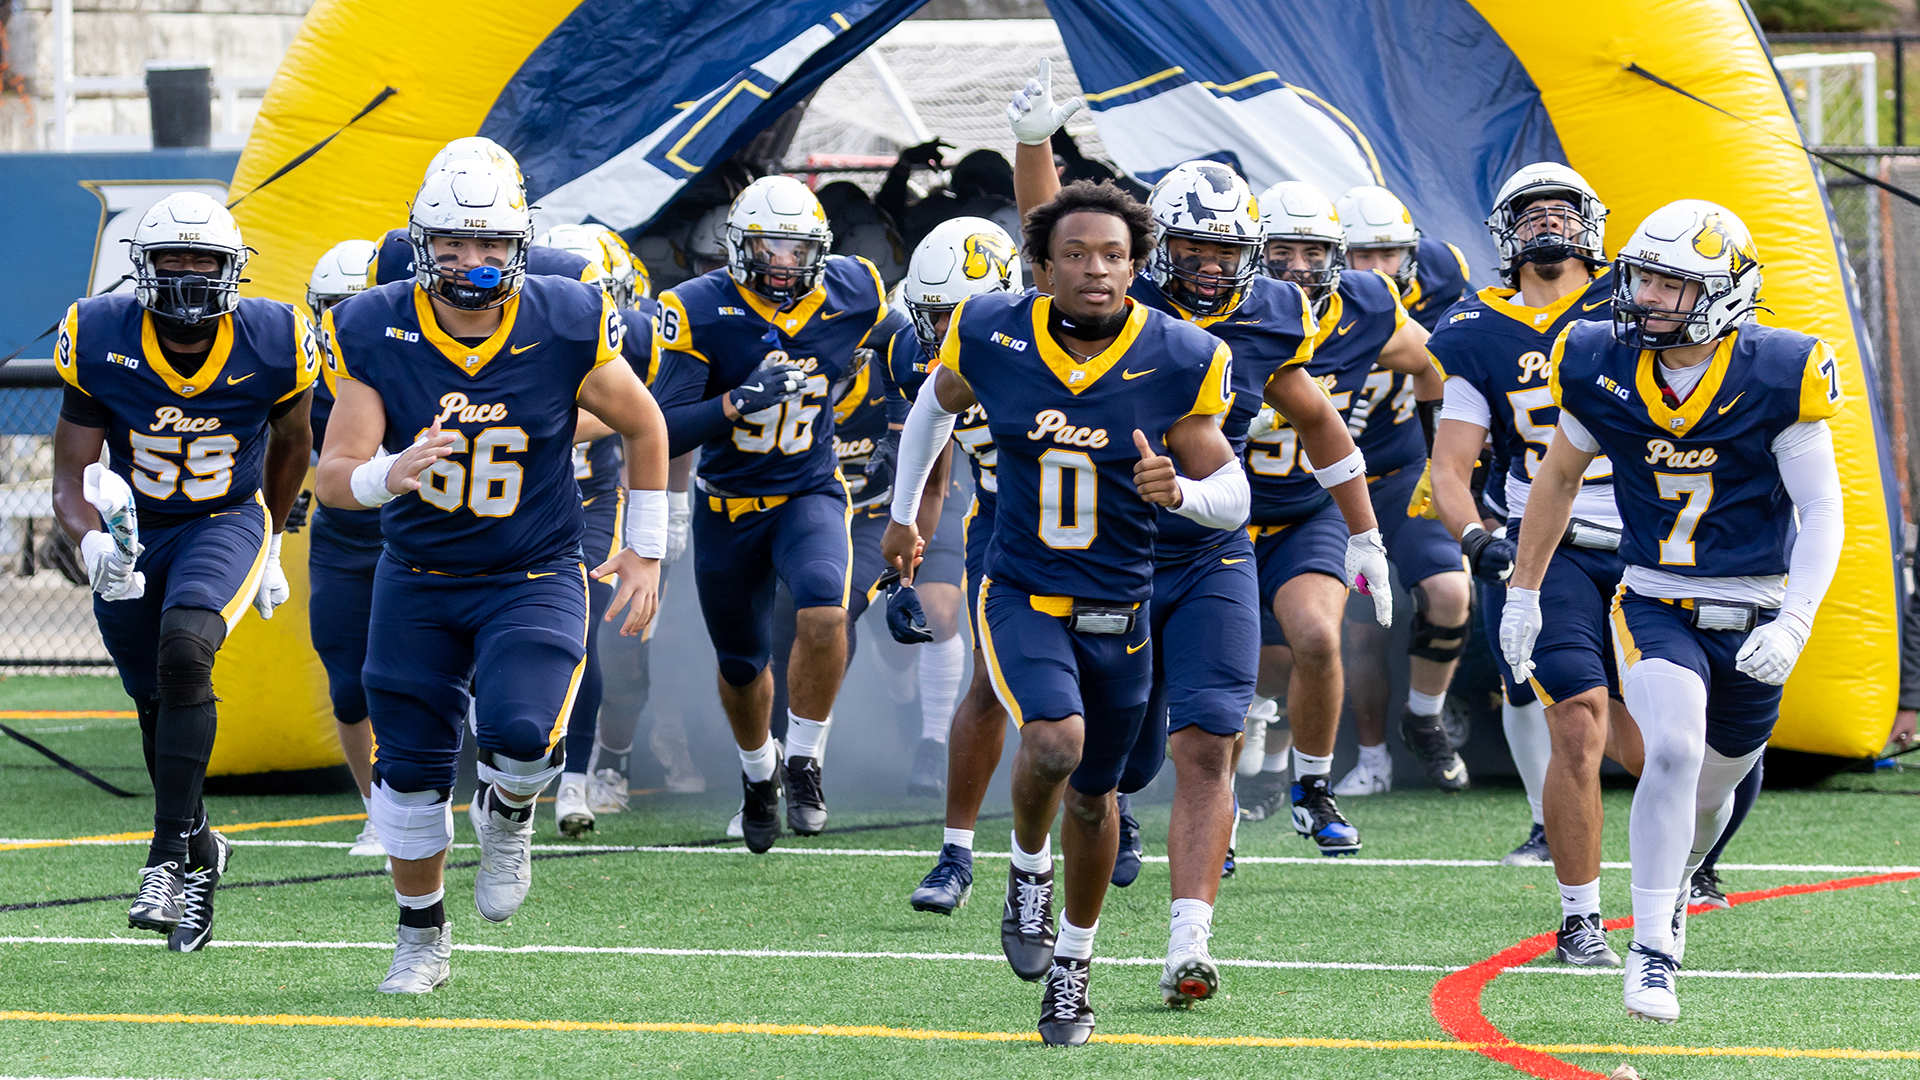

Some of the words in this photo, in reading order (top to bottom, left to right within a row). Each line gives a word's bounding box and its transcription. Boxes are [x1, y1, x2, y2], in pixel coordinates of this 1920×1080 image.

[462, 219, 487, 228] PACE
[778, 222, 798, 231] PACE
[1207, 222, 1230, 233] PACE
[178, 232, 200, 241] PACE
[1639, 249, 1660, 262] PACE
[922, 294, 941, 302] PACE
[718, 306, 746, 317] NE10
[1449, 311, 1481, 325] NE10
[1534, 312, 1549, 326] P
[385, 326, 419, 343] NE10
[989, 331, 1028, 352] NE10
[106, 351, 139, 370] NE10
[464, 355, 480, 368] P
[1068, 370, 1086, 384] P
[1817, 352, 1842, 405] 7
[179, 386, 195, 395] P
[1595, 373, 1631, 401] NE10
[434, 391, 508, 424] Pace
[731, 374, 829, 456] 96
[149, 406, 222, 432] Pace
[1669, 417, 1686, 430] P
[1027, 409, 1109, 449] Pace
[1644, 439, 1719, 469] Pace
[128, 429, 240, 502] 59
[414, 426, 530, 518] 66
[1038, 447, 1098, 550] 0
[1653, 471, 1715, 567] 7
